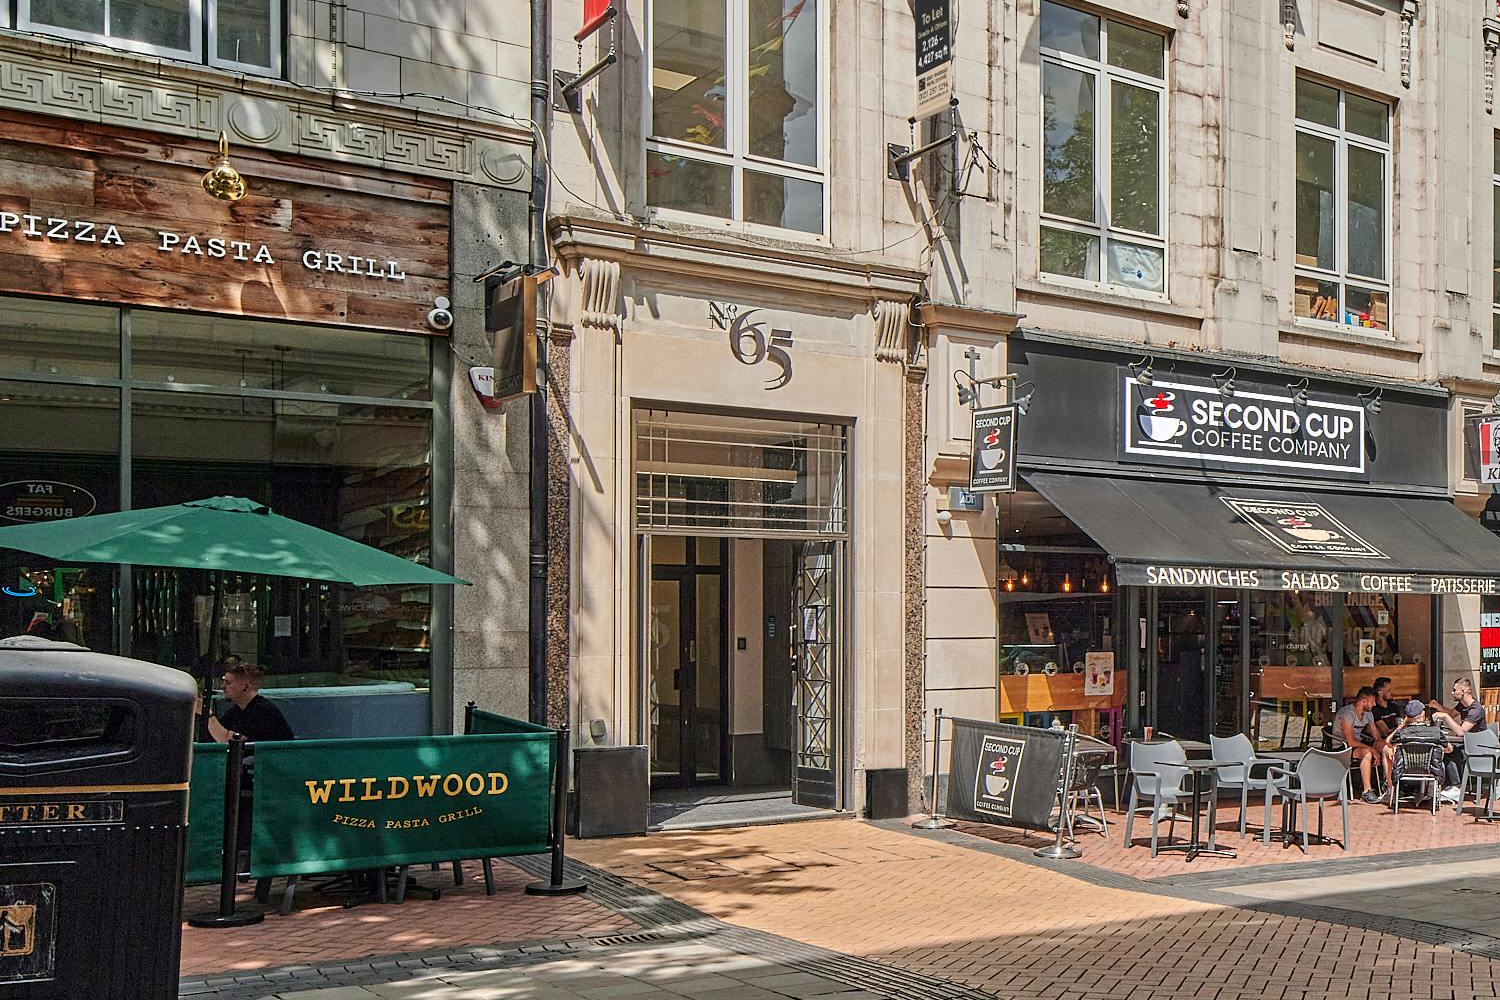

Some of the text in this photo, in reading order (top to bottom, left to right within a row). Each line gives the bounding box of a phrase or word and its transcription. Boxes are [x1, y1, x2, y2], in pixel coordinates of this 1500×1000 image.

[921, 6, 943, 25] To Let
[0, 212, 405, 280] PIZZA PASTA GRILL
[729, 309, 794, 391] 65
[975, 416, 1011, 428] SECOND CUP
[1191, 399, 1353, 440] SECOND CUP
[1191, 428, 1351, 460] COFFEE COMPANY
[1241, 506, 1320, 517] SECOND CUP
[1147, 566, 1259, 588] SANDWICHES
[1281, 571, 1340, 590] SALADS
[1361, 575, 1413, 592] COFFEE
[1431, 578, 1496, 594] PATISSERIE
[984, 742, 1020, 756] SECOND CUP
[305, 772, 508, 804] WILDWOOD
[332, 806, 483, 829] PIZZA PASTA GRILL
